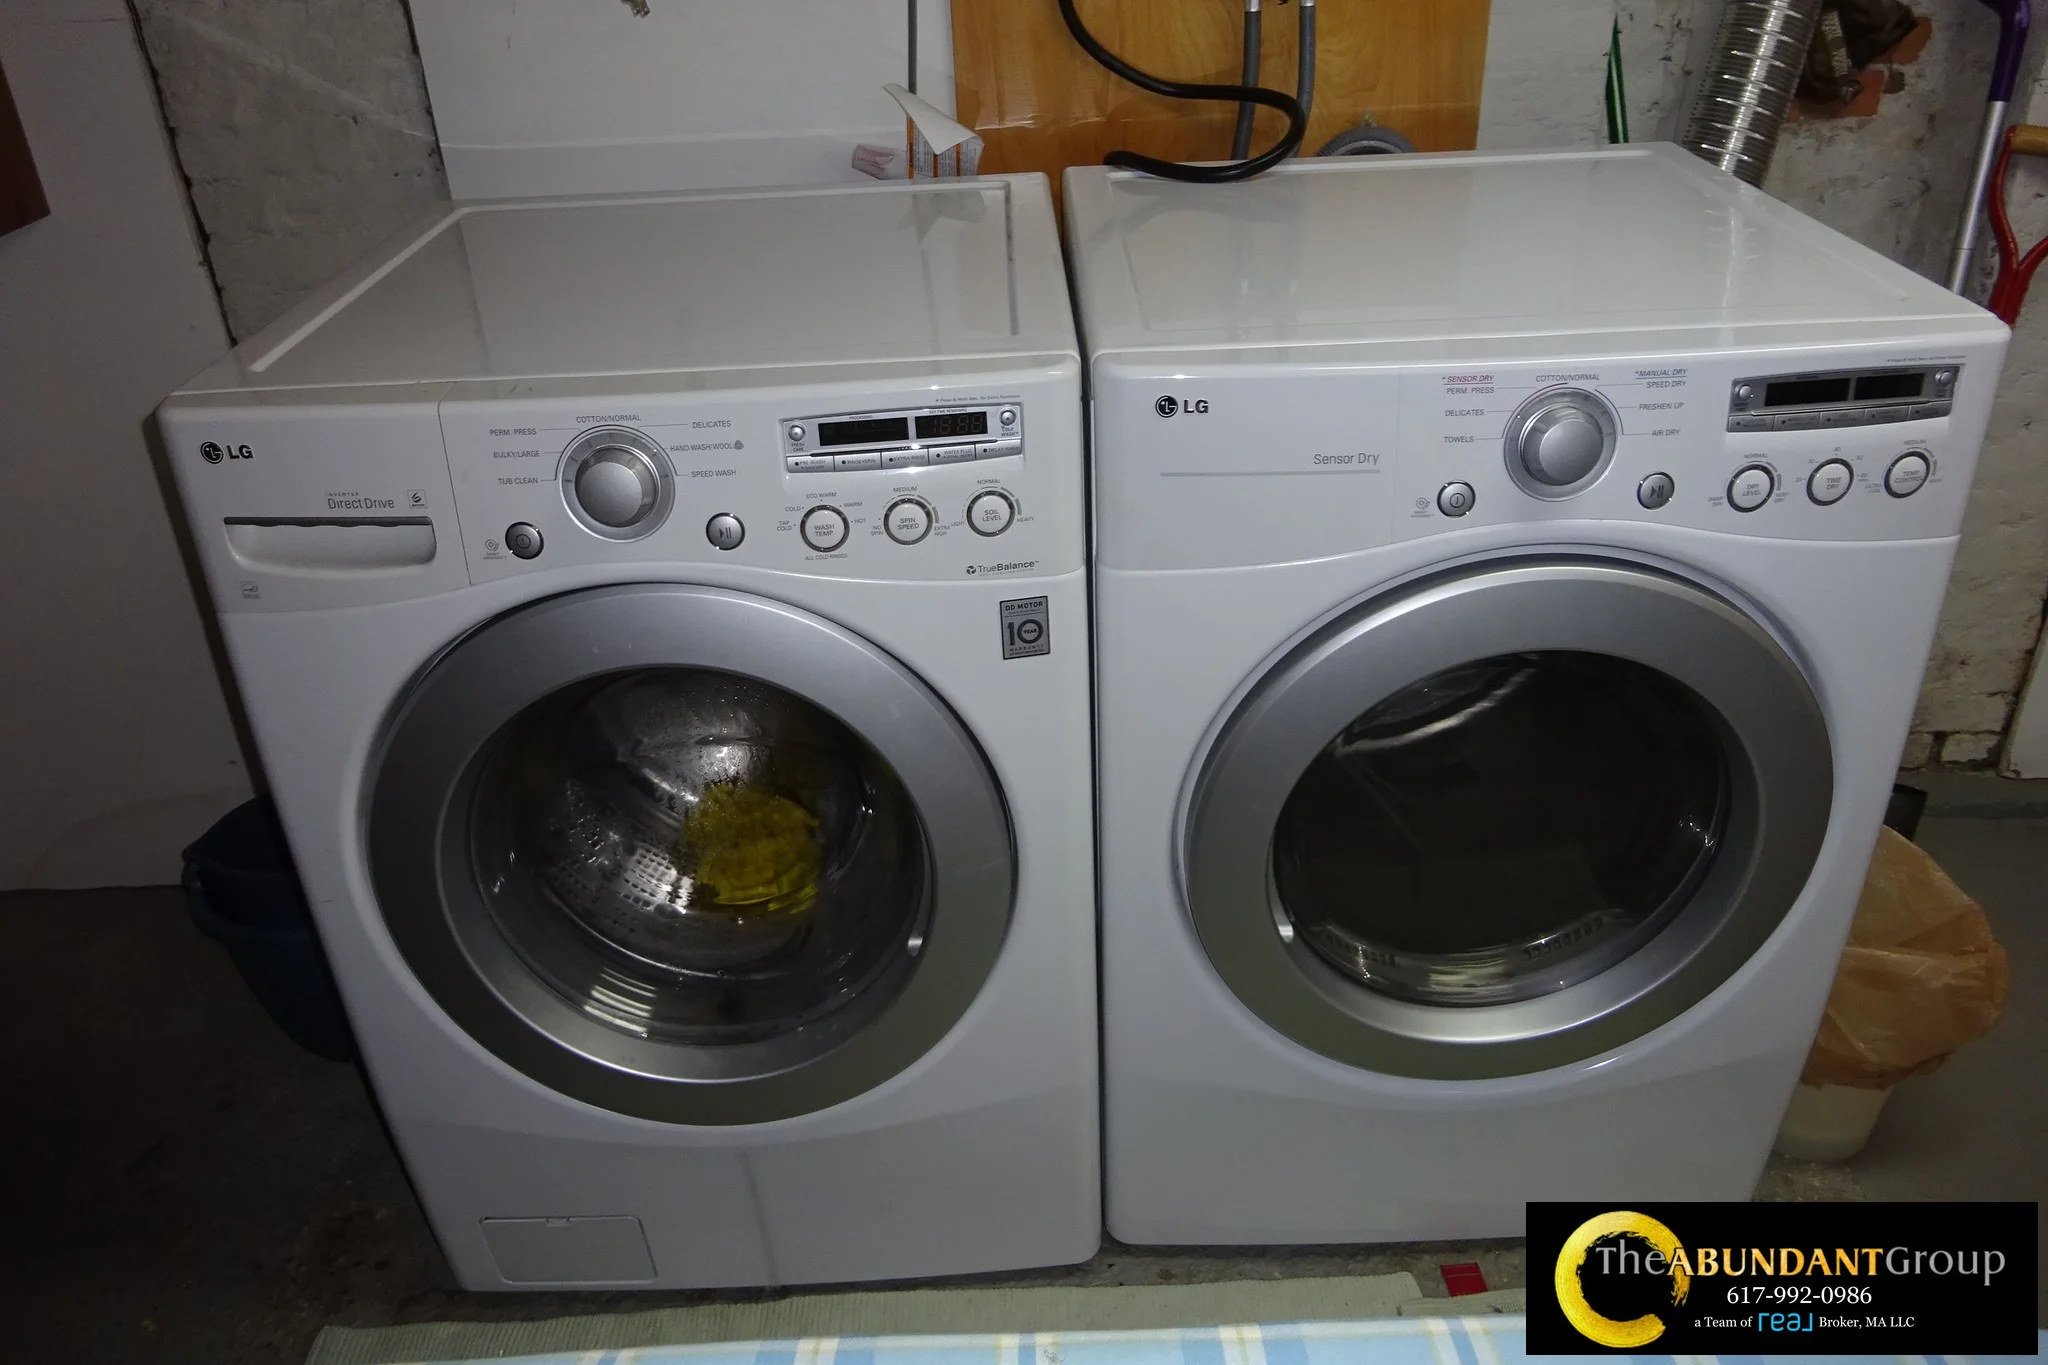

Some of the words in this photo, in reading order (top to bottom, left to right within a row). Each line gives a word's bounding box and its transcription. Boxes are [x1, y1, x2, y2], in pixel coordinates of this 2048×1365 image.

[1672, 368, 1688, 376] DRY
[1478, 374, 1495, 382] DRY
[1535, 373, 1601, 382] COTTON/NORMAL
[1671, 380, 1687, 388] DRY
[1446, 387, 1469, 395] PERM.
[1471, 386, 1495, 394] PRESS
[1183, 399, 1209, 414] LG
[1639, 402, 1672, 411] FRESHEN
[1445, 409, 1485, 417] DELICATES
[575, 414, 642, 423] COTTON/NORMAL
[692, 420, 732, 429] DELICATES
[490, 427, 512, 437] PERM.
[513, 427, 537, 436] PRESS
[1651, 429, 1664, 437] AIR
[1665, 428, 1681, 436] DRY
[227, 444, 254, 459] LG
[670, 443, 690, 453] HAND
[691, 442, 734, 452] WASH/WOOL
[493, 449, 541, 459] BULKY/LARGE
[1313, 453, 1355, 465] Sensor
[1358, 452, 1380, 466] Dry
[691, 469, 713, 478] SPEED
[714, 468, 737, 477] WASH
[498, 477, 513, 485] TUB
[514, 477, 539, 485] CLEAN
[327, 497, 363, 511] Direct
[364, 497, 395, 509] Drive
[784, 505, 802, 513] COLD
[899, 516, 916, 524] SPIN
[982, 514, 1003, 522] LEVEL
[813, 523, 835, 531] WASH
[897, 522, 920, 531] SPEED
[829, 552, 849, 560] RINSES
[1005, 604, 1016, 612] DD
[1017, 600, 1043, 610] MOTOR
